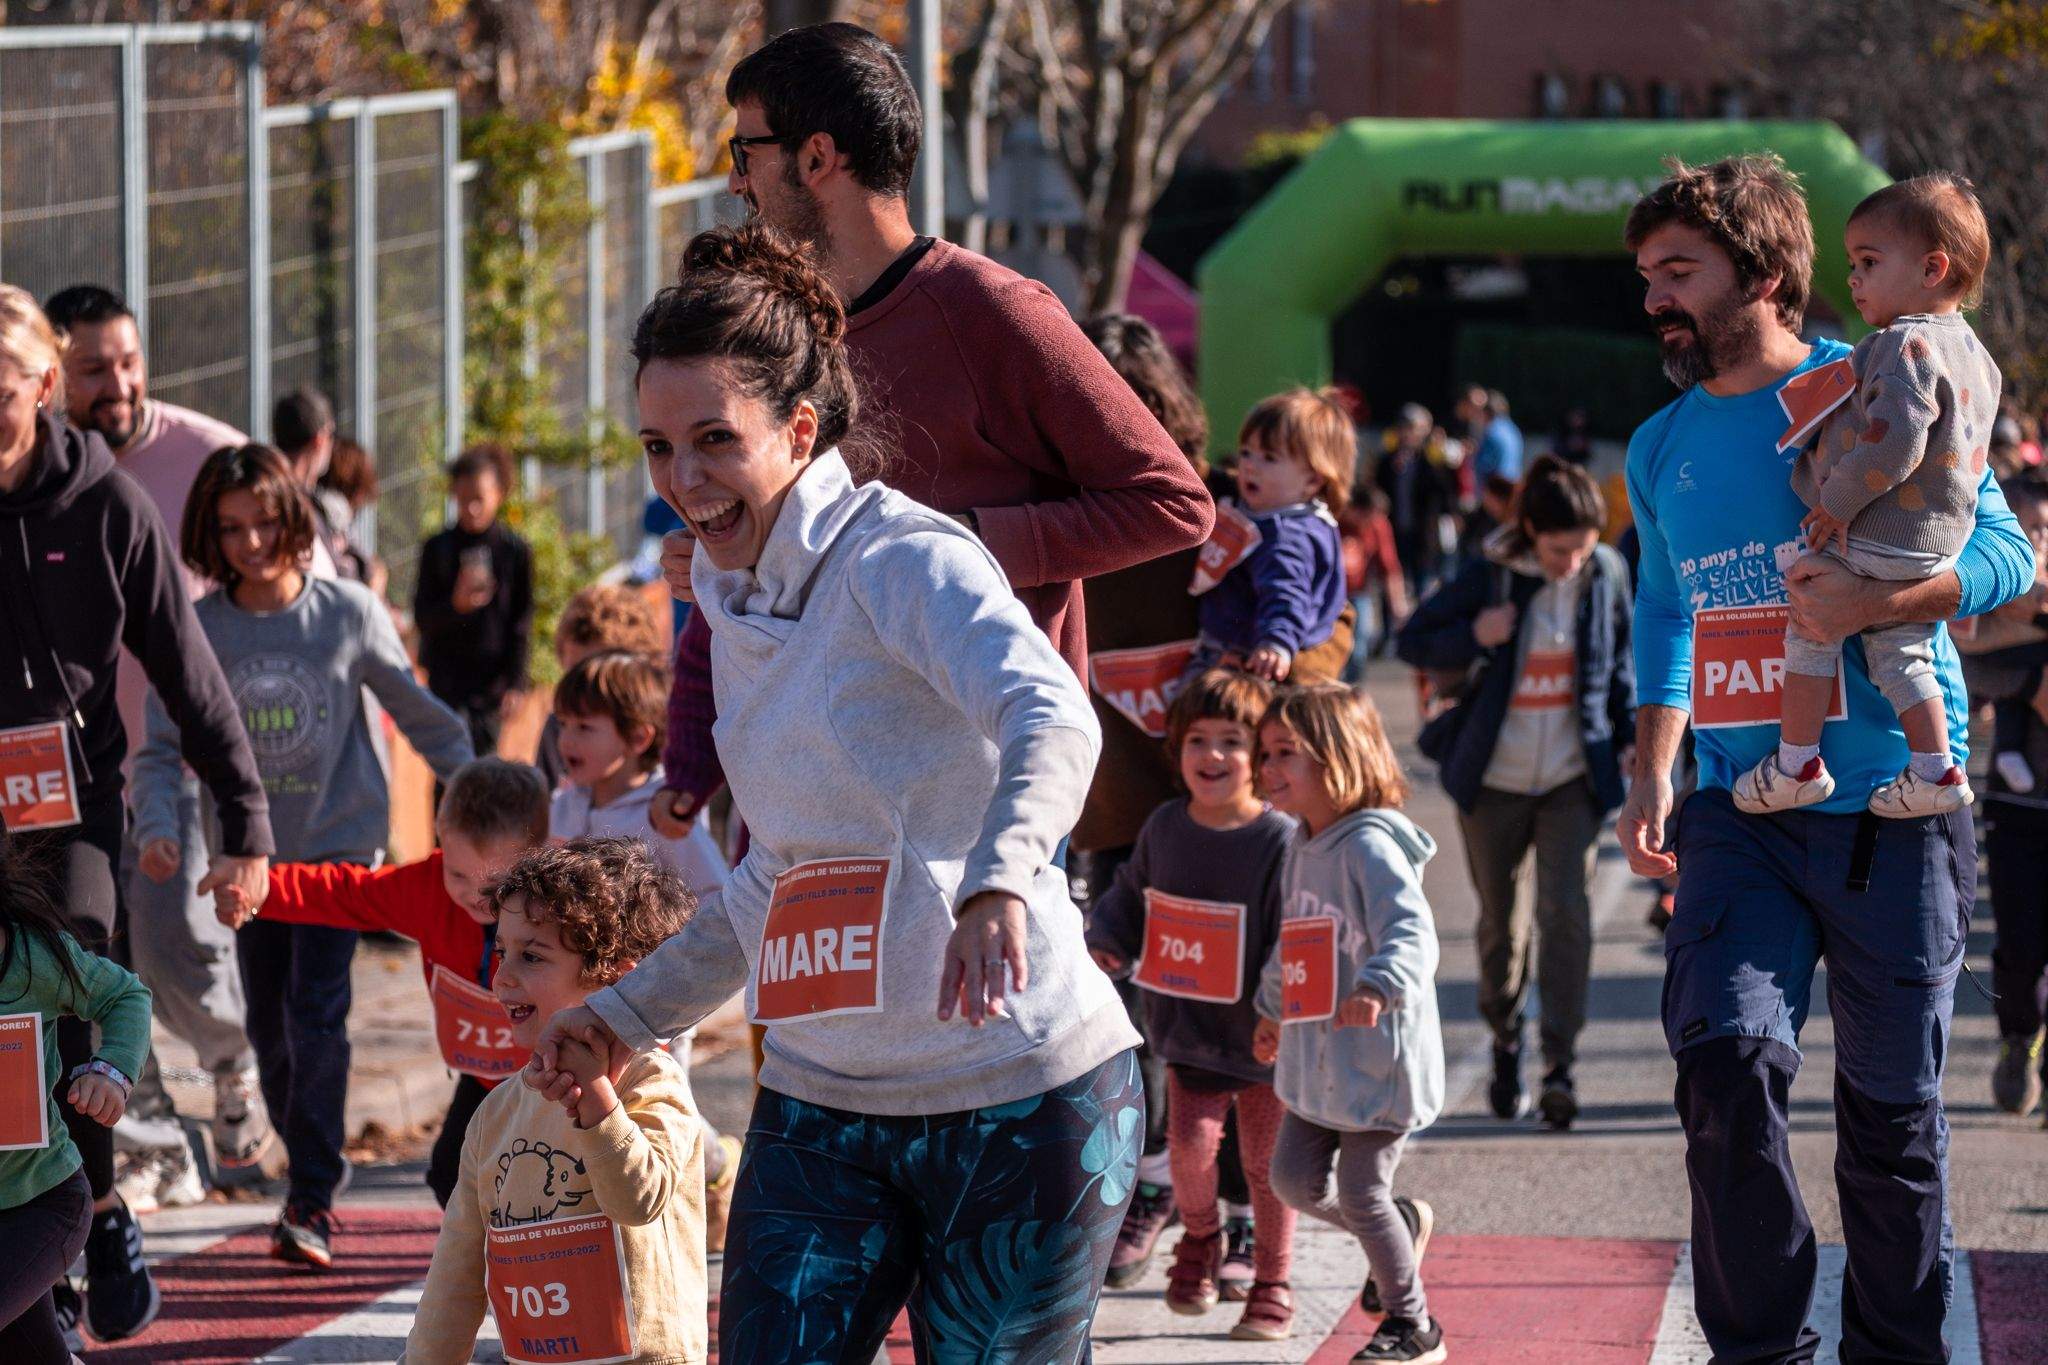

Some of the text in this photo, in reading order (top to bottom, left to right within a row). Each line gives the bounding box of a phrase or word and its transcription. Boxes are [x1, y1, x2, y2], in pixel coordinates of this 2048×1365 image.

[1680, 541, 1766, 577] 20 anys de
[0, 769, 66, 807] RE
[817, 868, 827, 876] DE
[829, 864, 882, 876] VALLDOREIX
[762, 925, 873, 985] MARE
[1159, 935, 1205, 964] 704
[457, 1018, 515, 1049] 712
[528, 1230, 542, 1240] DE
[544, 1220, 608, 1237] VALLDOREIX
[504, 1282, 570, 1318] 703
